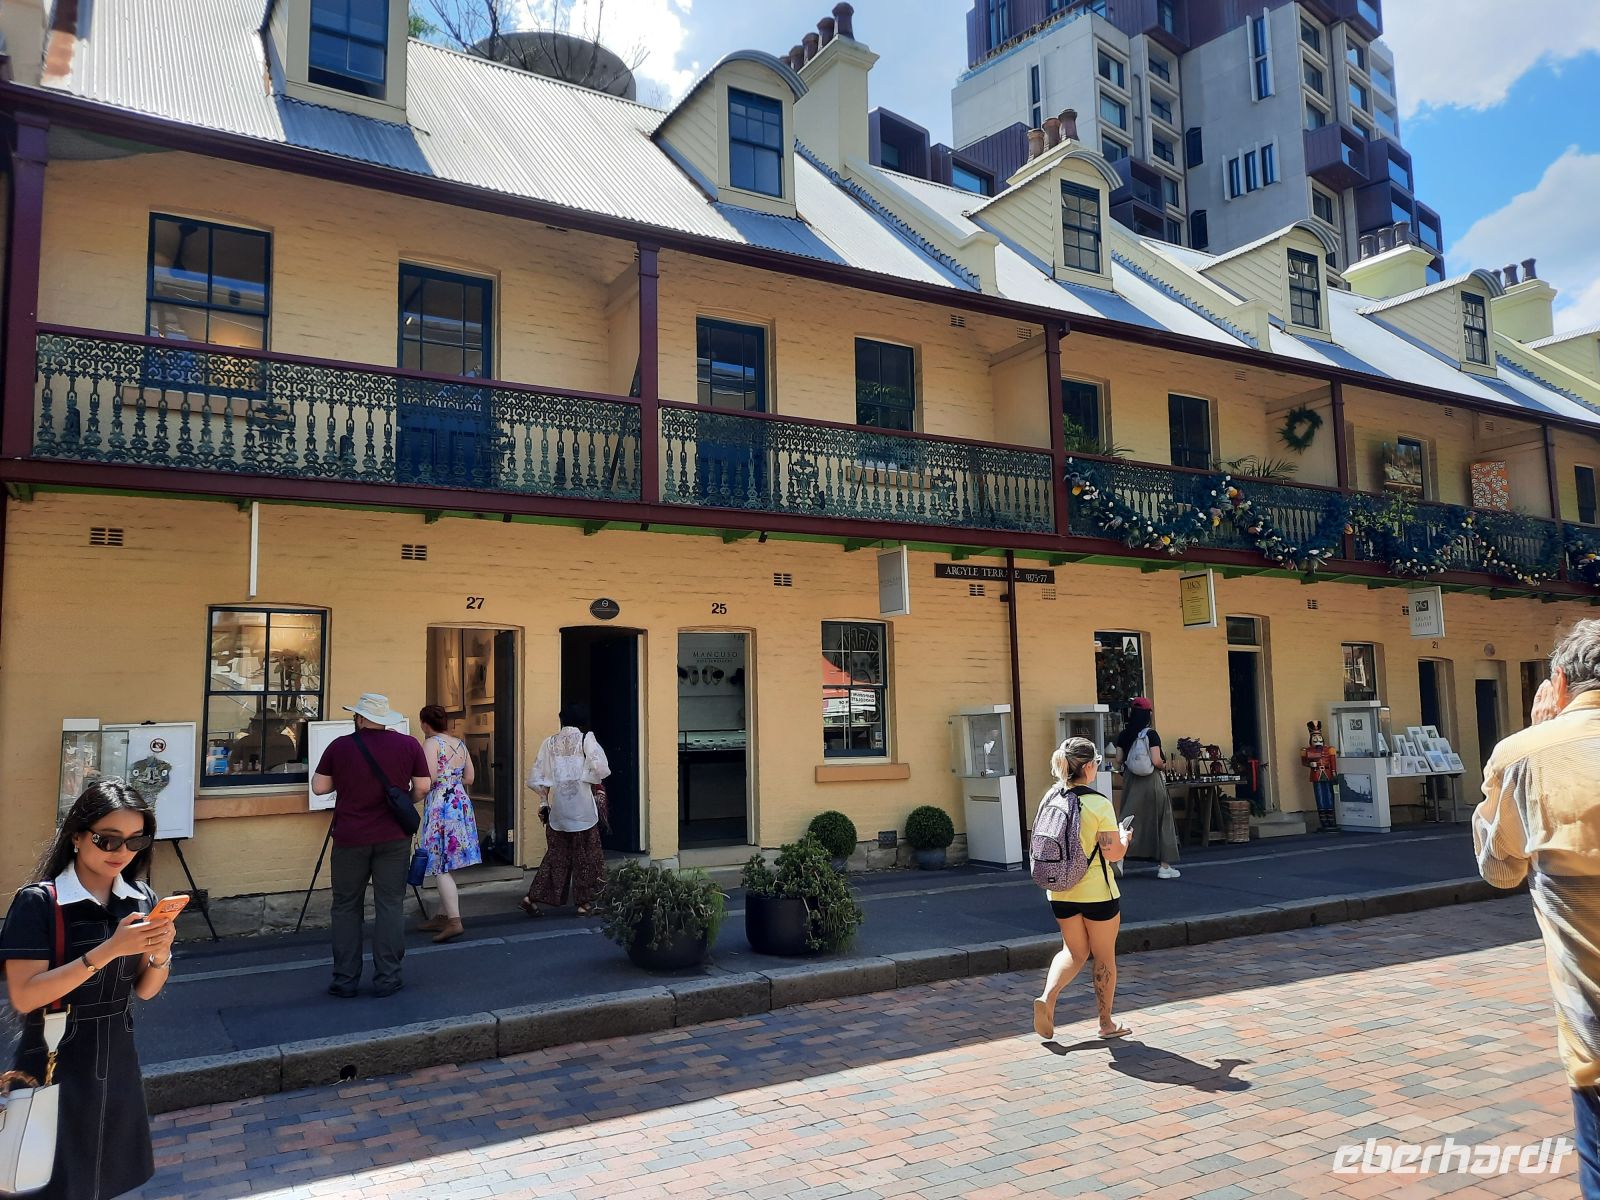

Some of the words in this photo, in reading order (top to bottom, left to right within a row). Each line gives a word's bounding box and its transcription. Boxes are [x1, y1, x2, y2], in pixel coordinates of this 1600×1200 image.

[945, 565, 979, 576] ARGYLE
[981, 567, 1020, 579] TERRE
[466, 596, 485, 610] 27
[711, 602, 727, 615] 25
[1432, 640, 1439, 649] 21
